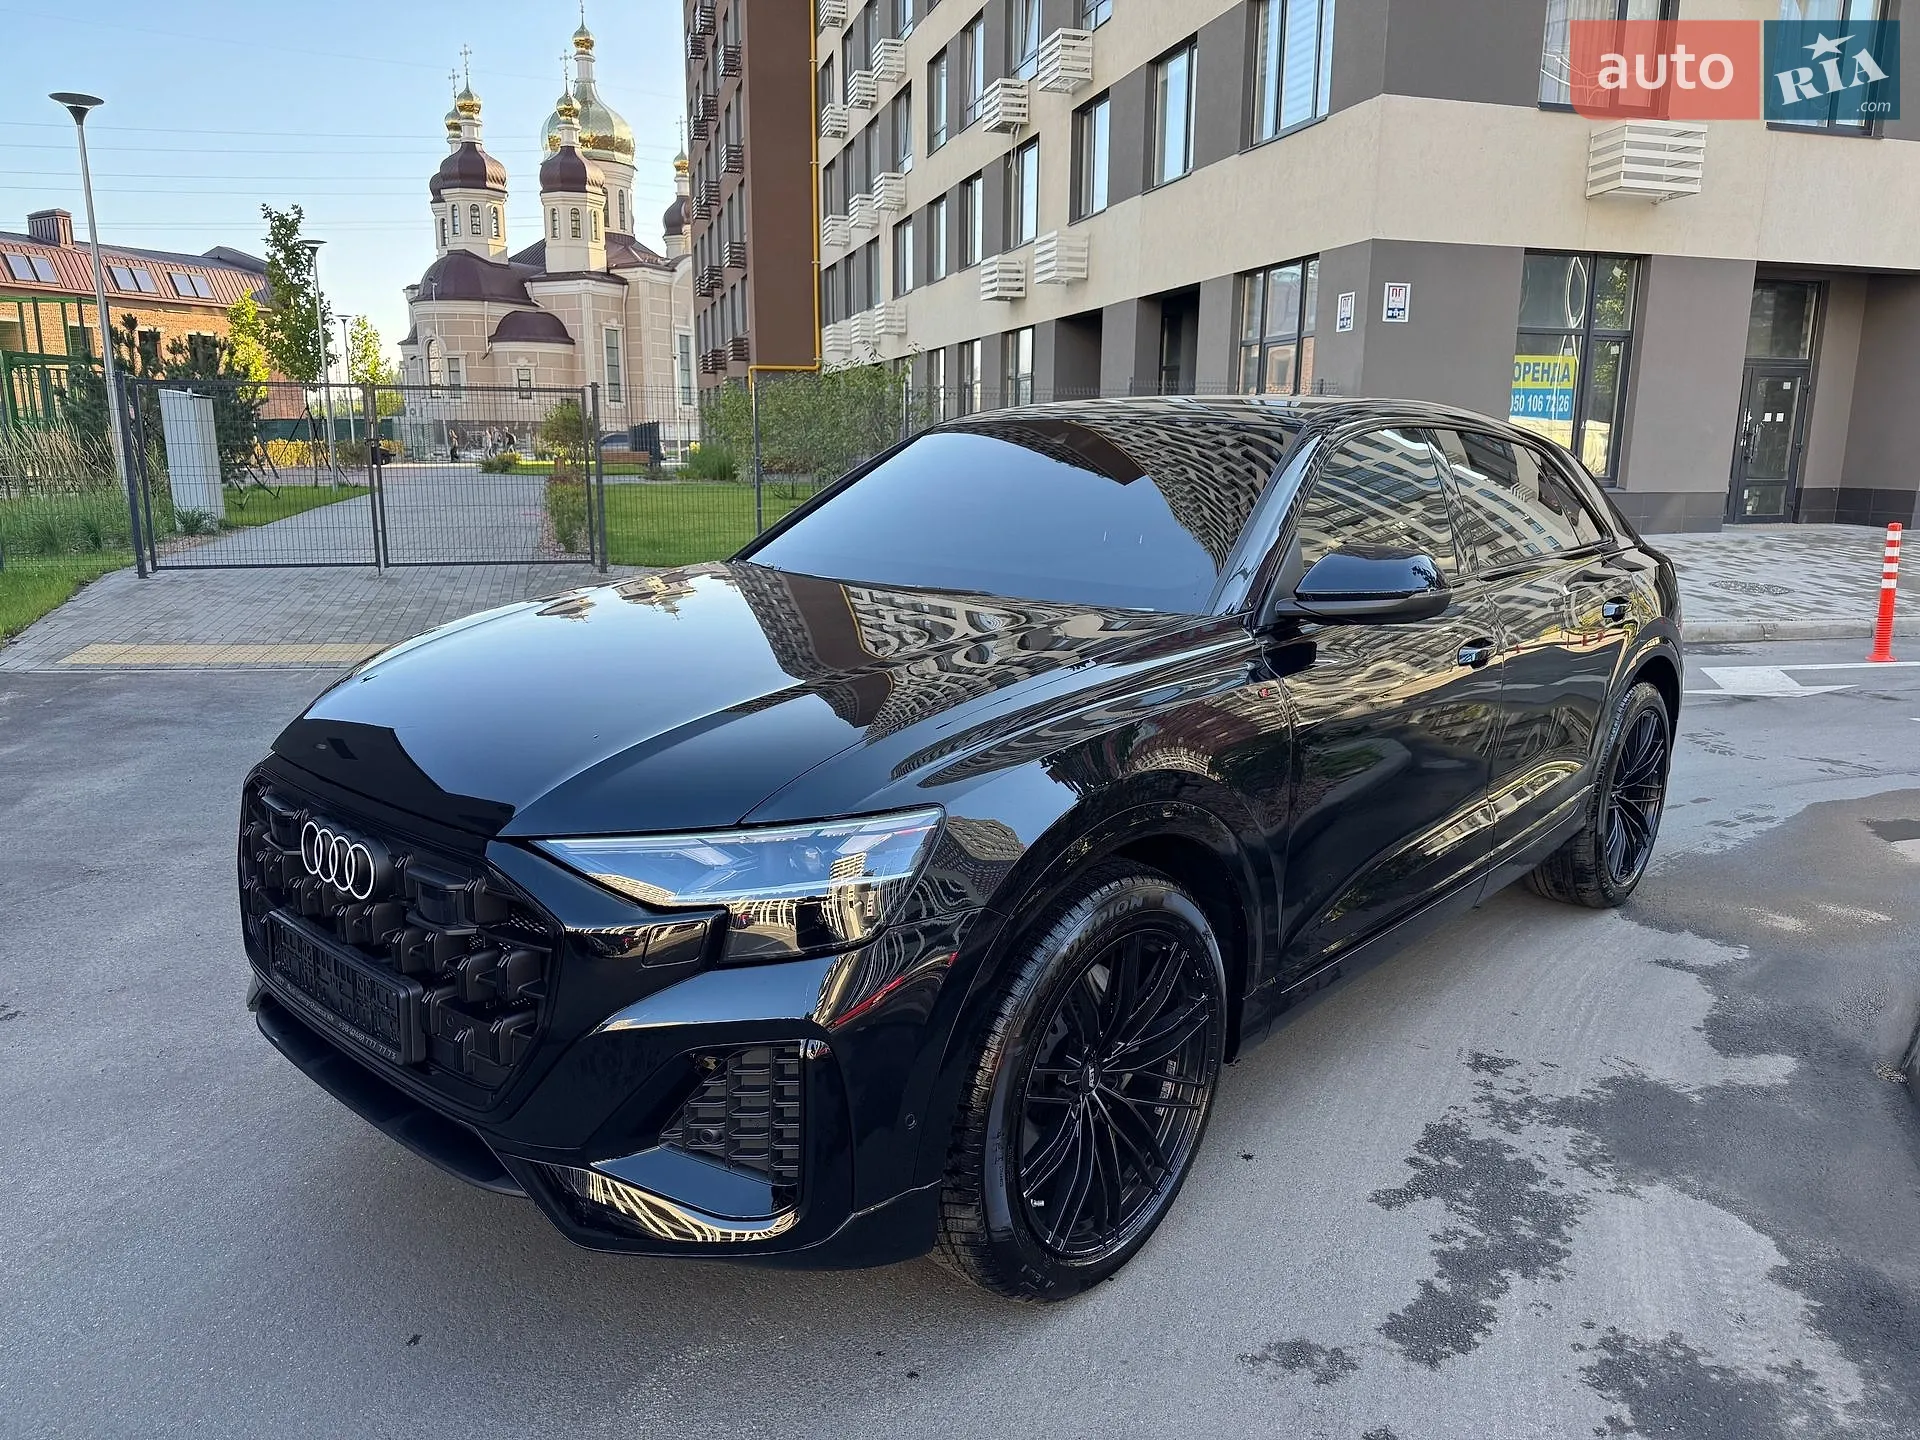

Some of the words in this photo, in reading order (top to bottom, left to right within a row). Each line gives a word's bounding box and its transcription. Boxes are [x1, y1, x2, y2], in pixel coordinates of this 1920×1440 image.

[1513, 361, 1571, 386] ОРЕНДА
[1527, 394, 1544, 412] 106
[1558, 394, 1570, 412] 26
